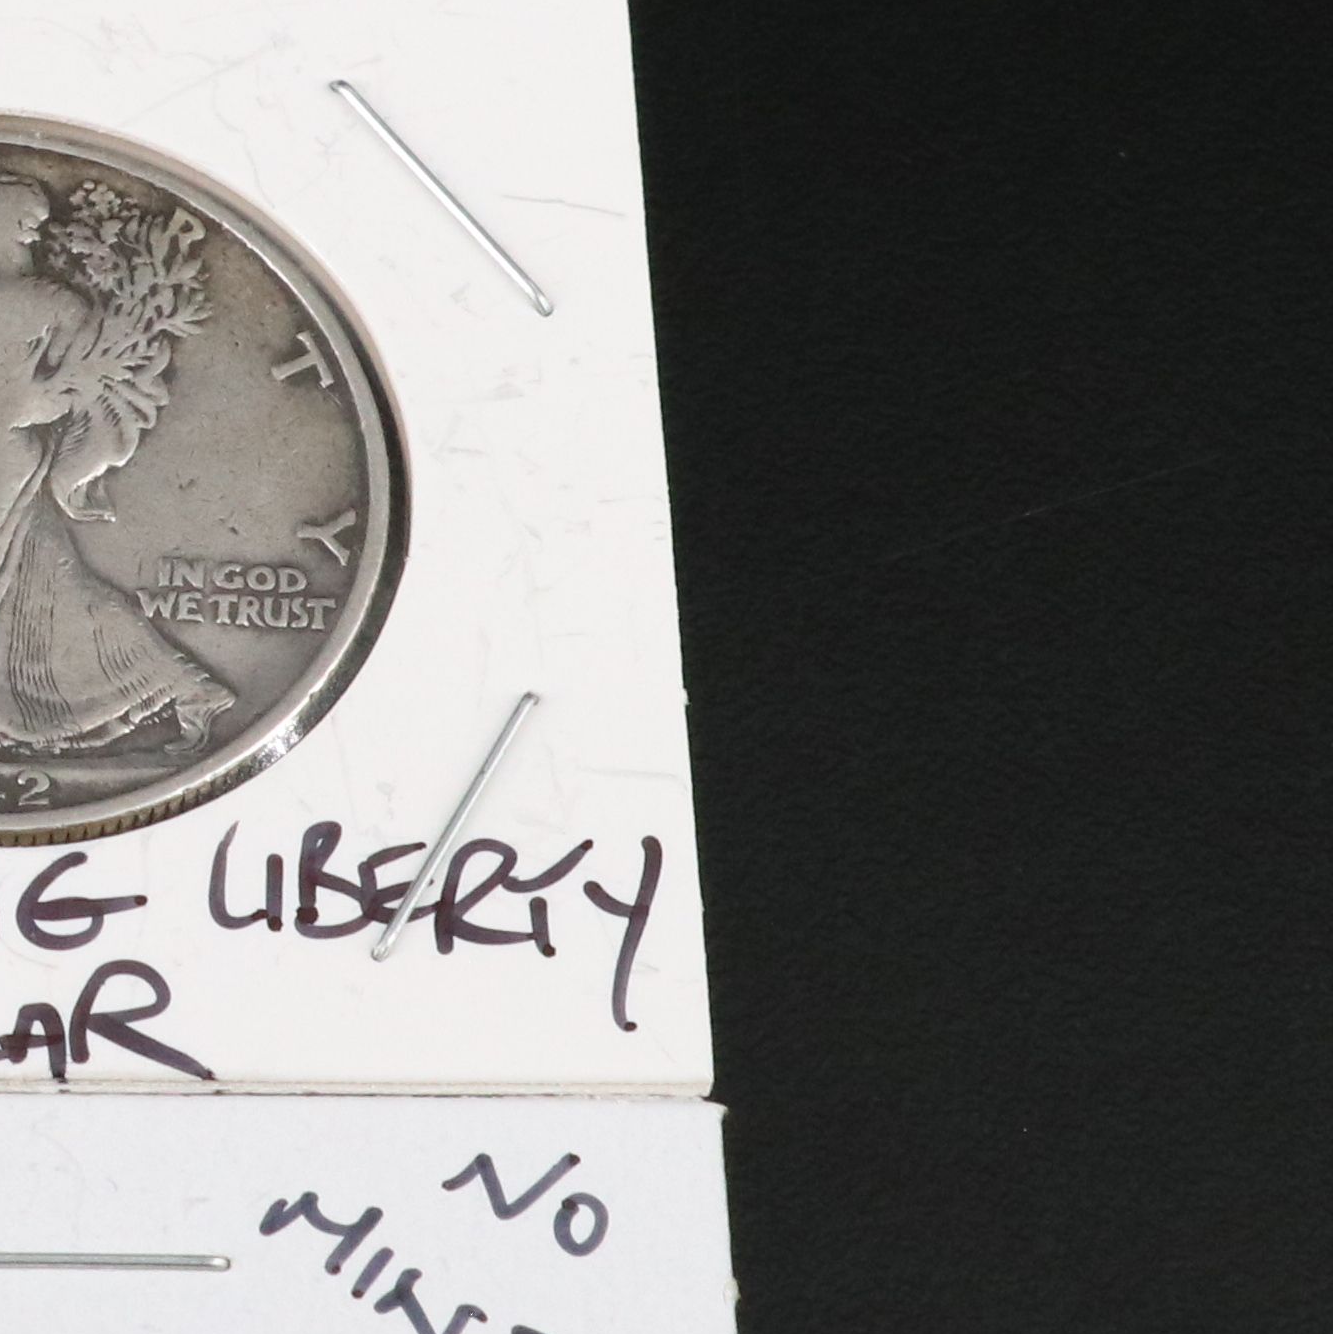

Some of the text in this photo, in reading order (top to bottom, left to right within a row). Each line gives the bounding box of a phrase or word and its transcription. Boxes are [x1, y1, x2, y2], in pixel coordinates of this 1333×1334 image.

[135, 588, 337, 630] WE TRUST
[158, 558, 307, 593] IN GOD
[207, 821, 664, 1033] LIBERTY
[441, 1152, 609, 1257] NO
